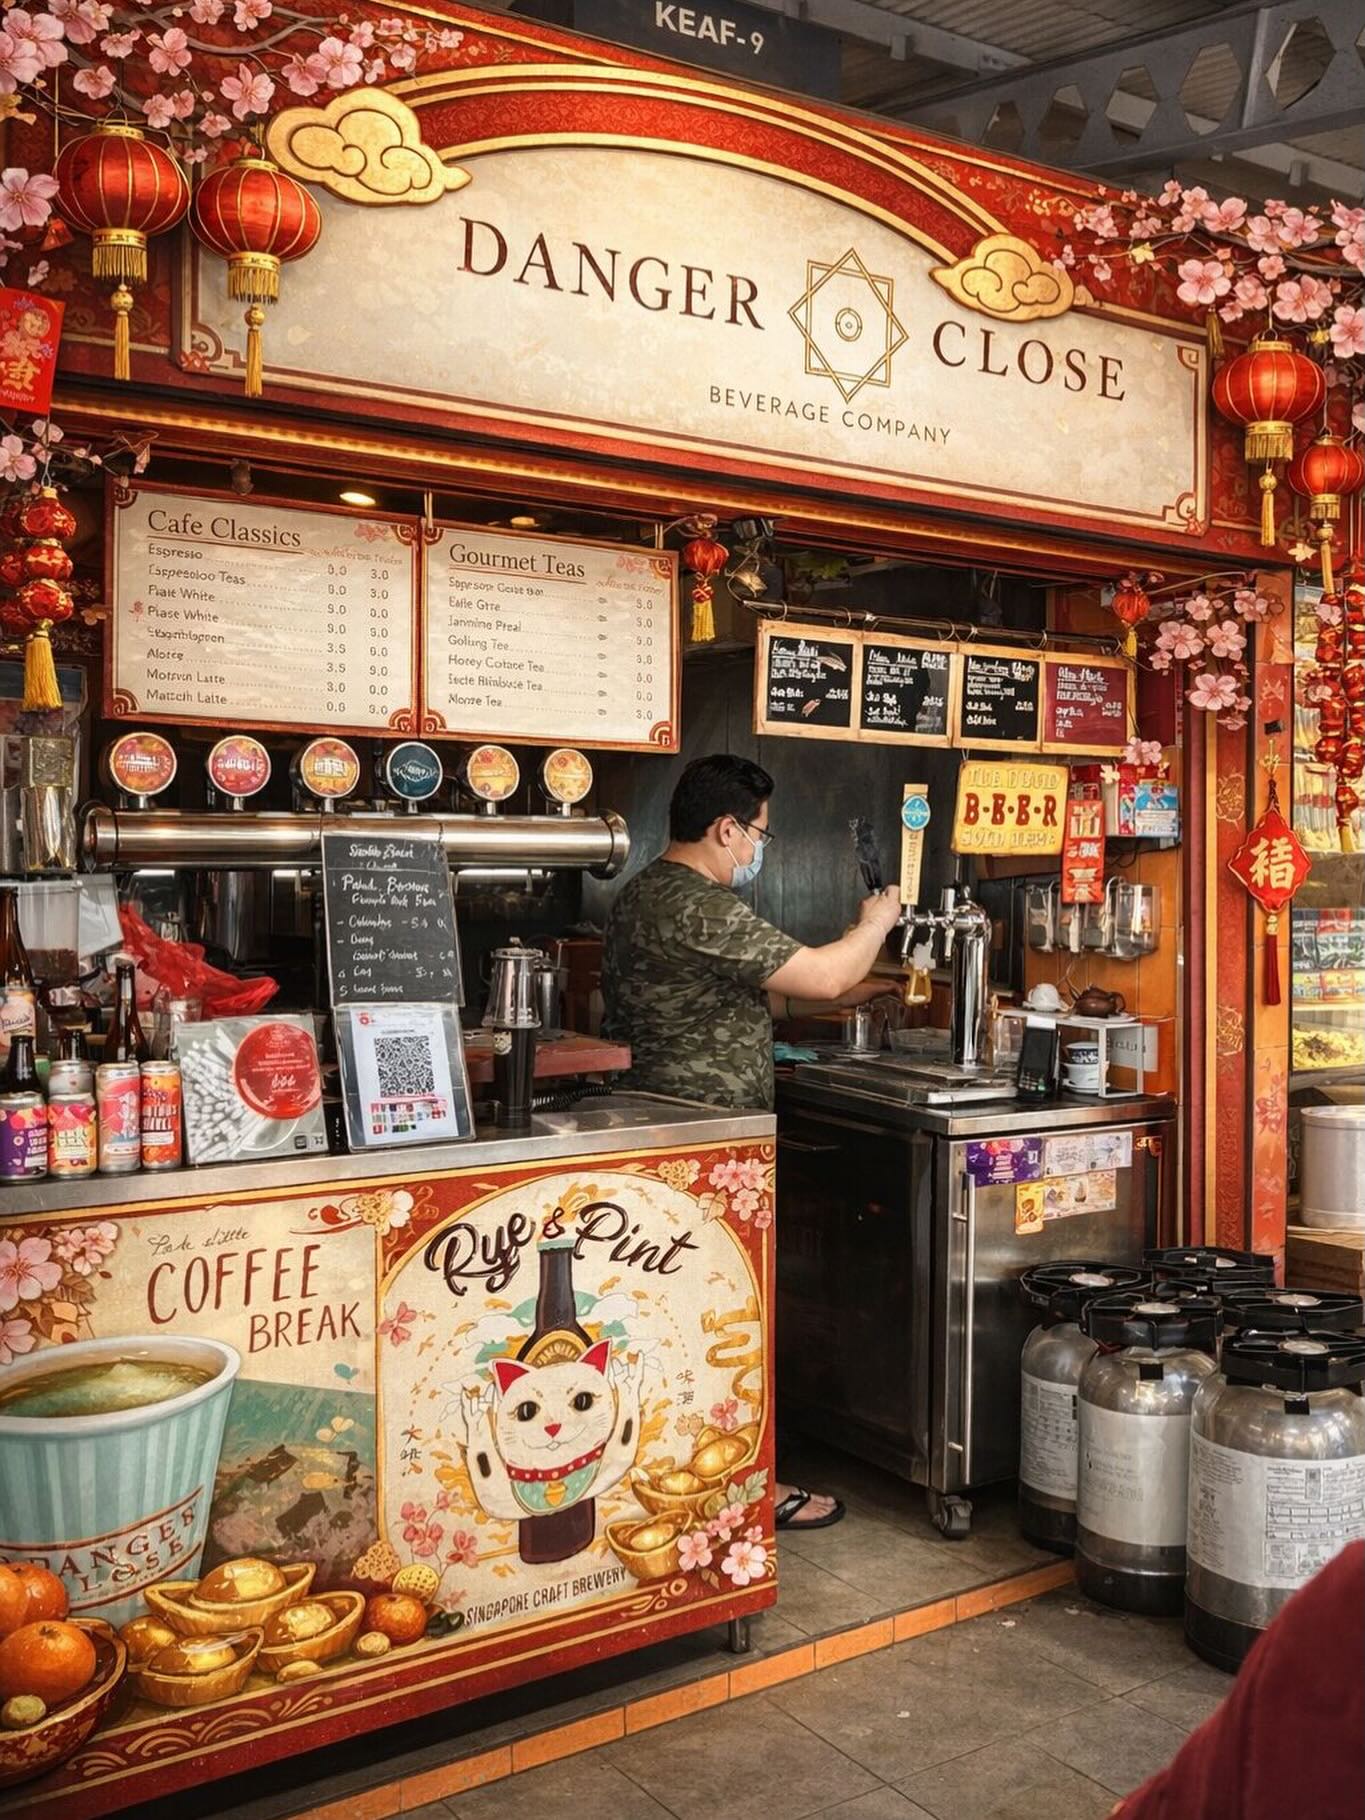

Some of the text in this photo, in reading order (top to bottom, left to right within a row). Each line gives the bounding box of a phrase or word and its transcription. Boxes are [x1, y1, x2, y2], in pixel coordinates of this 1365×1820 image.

[655, 0, 765, 55] KEAF-9
[456, 216, 1127, 402] DANGER CLOSE
[709, 385, 952, 446] BEVERAGE COMPANY
[148, 509, 302, 547] Cafe Classics
[449, 543, 585, 578] Gourmet Teas
[424, 1212, 537, 1297] Rye
[572, 1201, 700, 1275] Pint
[147, 1244, 321, 1325] COFFEE
[247, 1301, 361, 1354] BREAK
[532, 1582, 569, 1607] CRAFT
[572, 1565, 627, 1597] BREWERY
